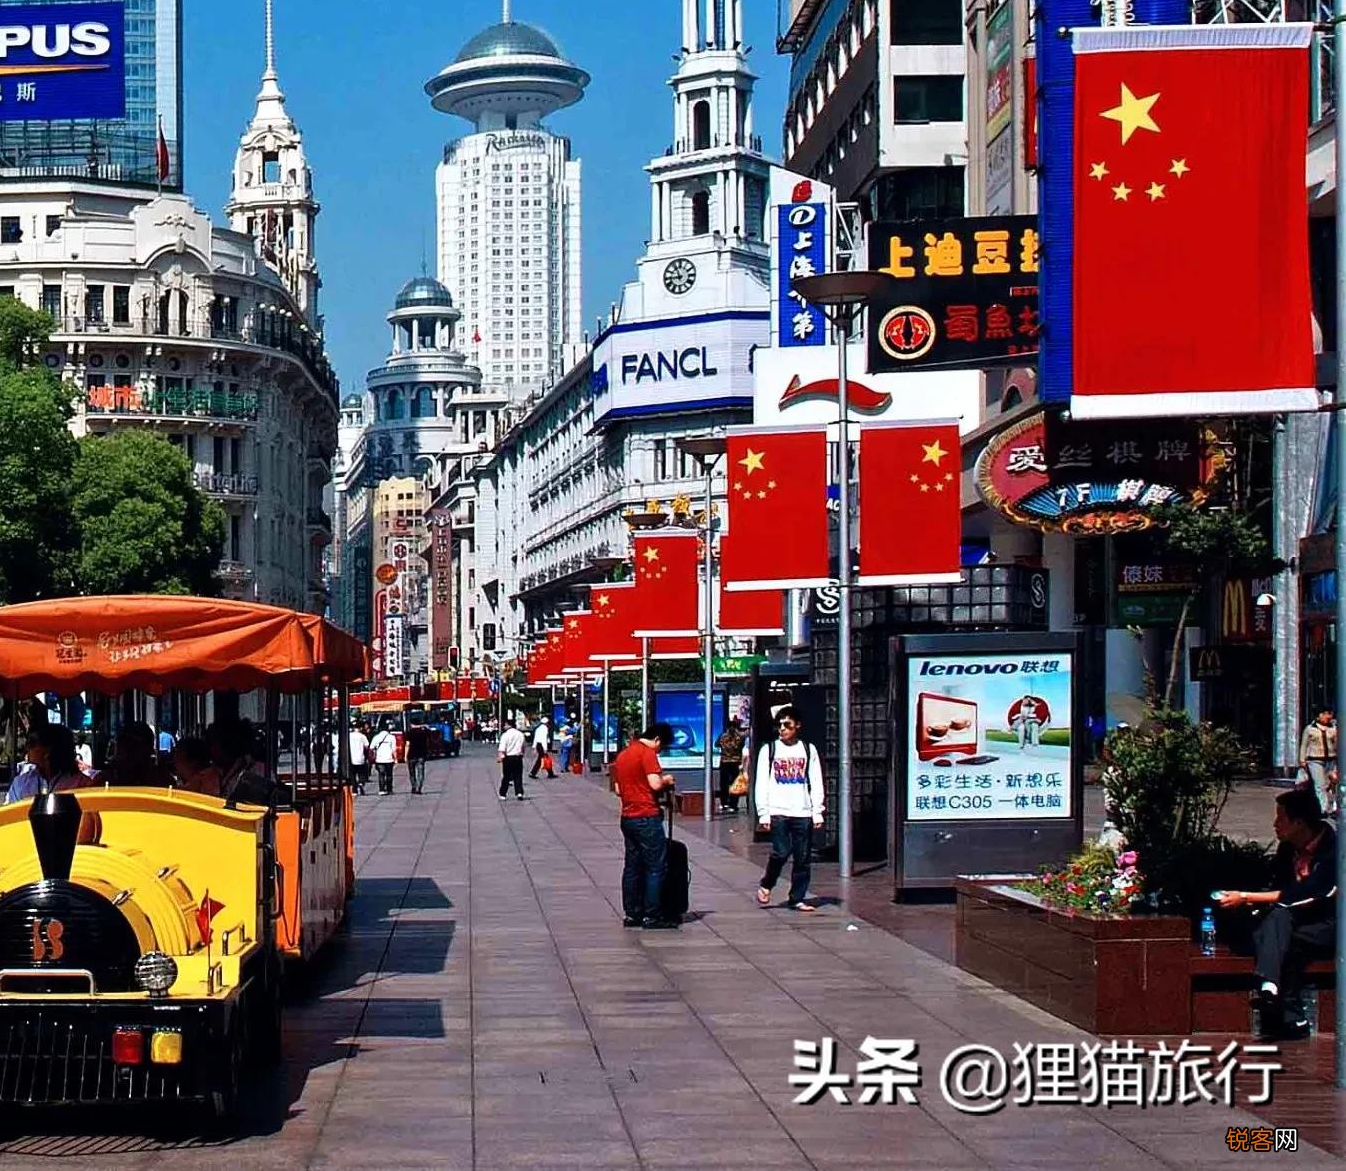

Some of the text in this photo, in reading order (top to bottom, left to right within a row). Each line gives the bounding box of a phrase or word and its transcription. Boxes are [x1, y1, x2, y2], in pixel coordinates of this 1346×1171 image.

[787, 231, 816, 340] 上海第
[621, 346, 717, 385] FANCL
[920, 660, 1018, 676] lenovo
[1020, 660, 1060, 673] 联想
[997, 795, 1062, 809] 一体电脑
